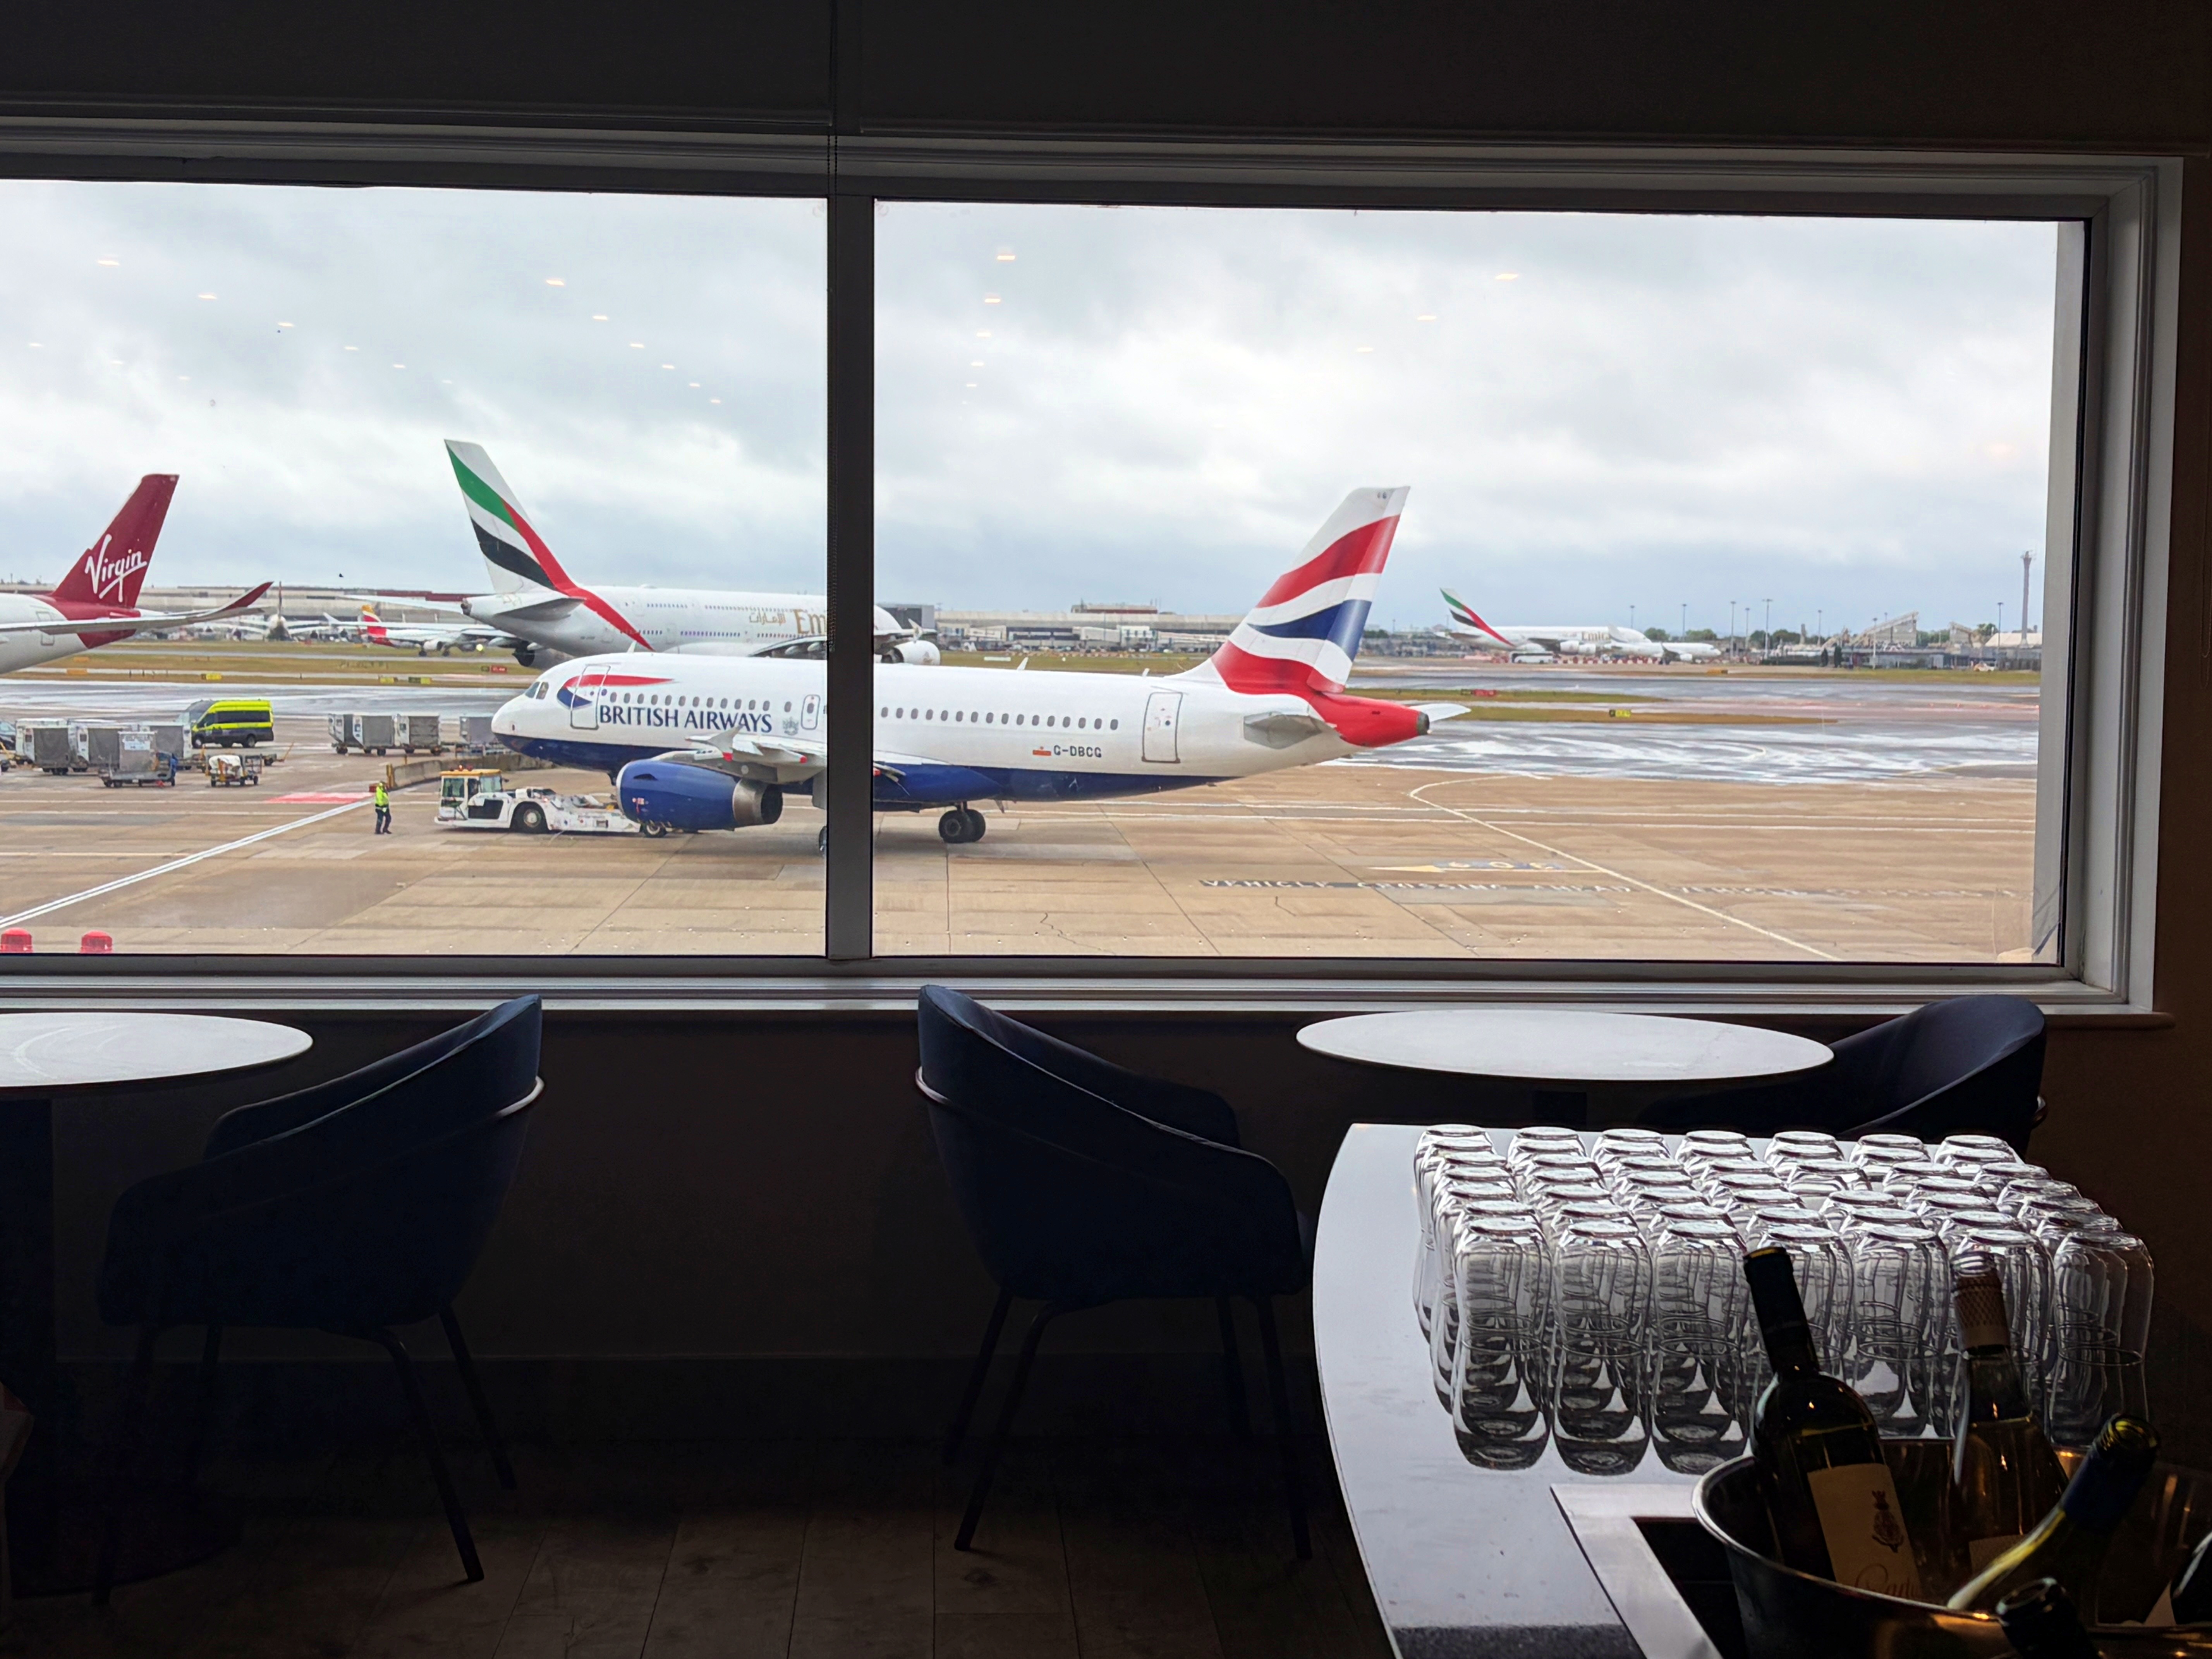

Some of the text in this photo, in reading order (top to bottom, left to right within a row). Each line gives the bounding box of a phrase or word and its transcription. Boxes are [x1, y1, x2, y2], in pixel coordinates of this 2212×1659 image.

[85, 534, 147, 603] Virgin
[600, 705, 773, 733] BRITISH AIRWAYS
[1053, 745, 1102, 758] G-DBCG
